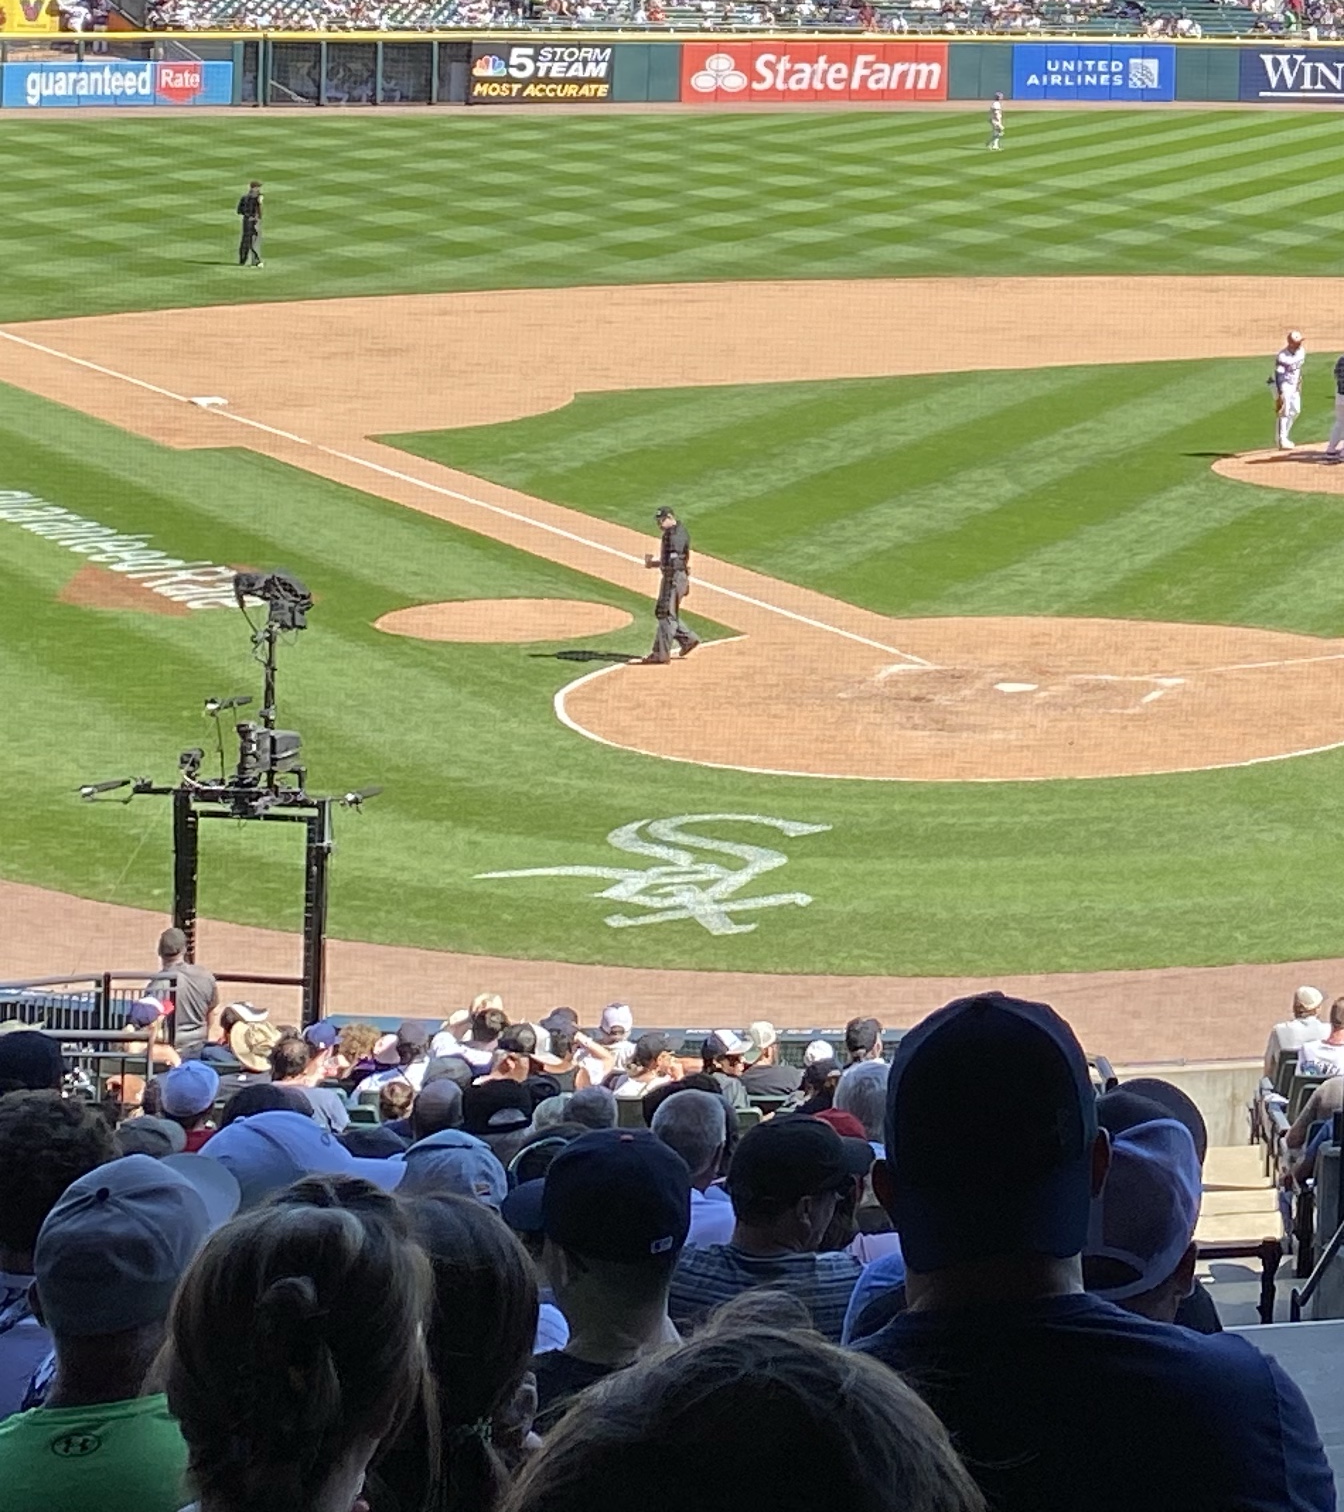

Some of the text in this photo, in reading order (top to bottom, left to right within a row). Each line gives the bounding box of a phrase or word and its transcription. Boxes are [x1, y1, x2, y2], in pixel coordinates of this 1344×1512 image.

[509, 47, 612, 78] 5 STORM
[1046, 60, 1123, 72] UNITED
[536, 63, 607, 78] TEAM
[27, 64, 200, 105] guaranteed Rate
[1027, 74, 1123, 86] AIRLINES
[474, 83, 608, 97] MOST ACCURATE
